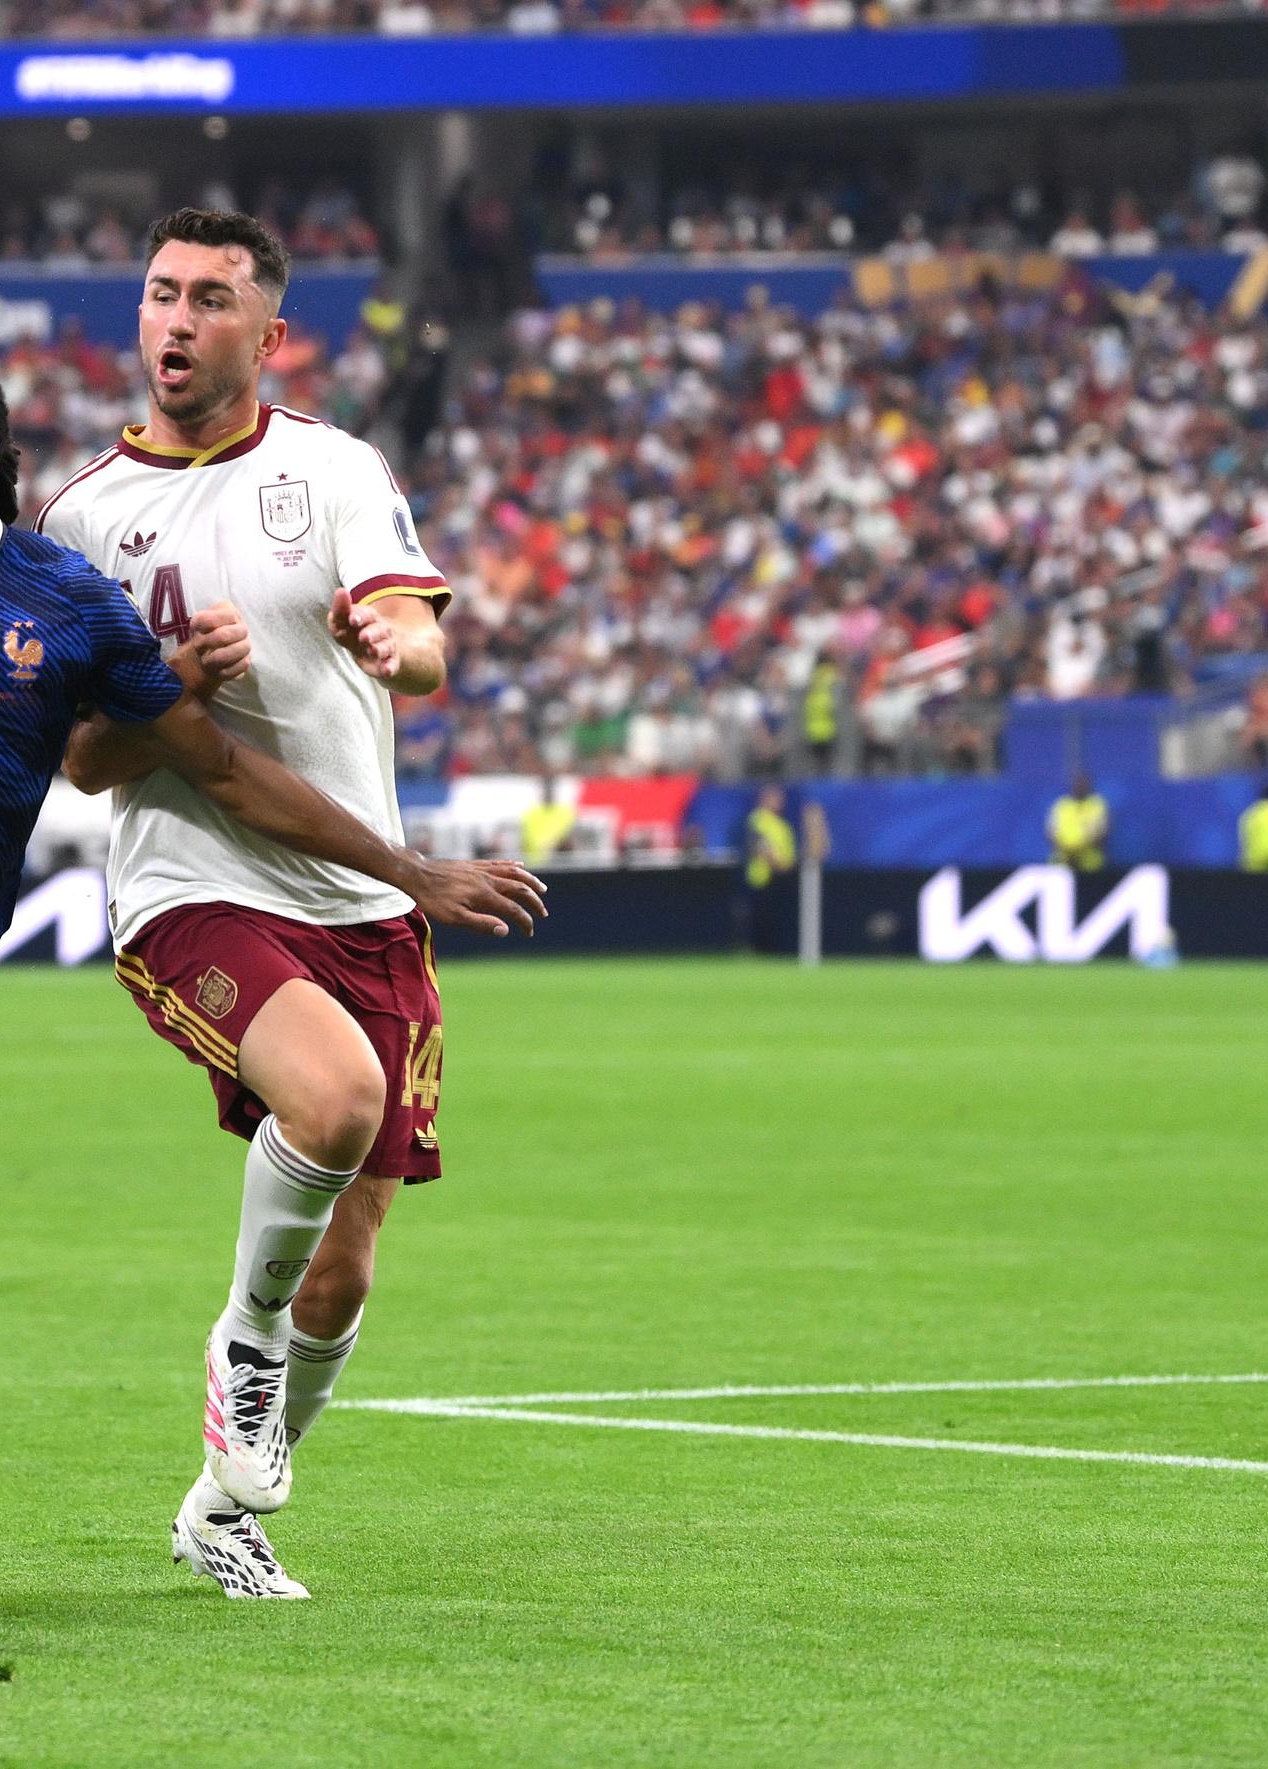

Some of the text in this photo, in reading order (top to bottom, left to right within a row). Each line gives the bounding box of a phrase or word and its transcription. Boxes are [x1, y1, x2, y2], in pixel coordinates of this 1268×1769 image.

[120, 563, 192, 646] 4
[918, 862, 1171, 964] KIA
[401, 1021, 443, 1110] 14
